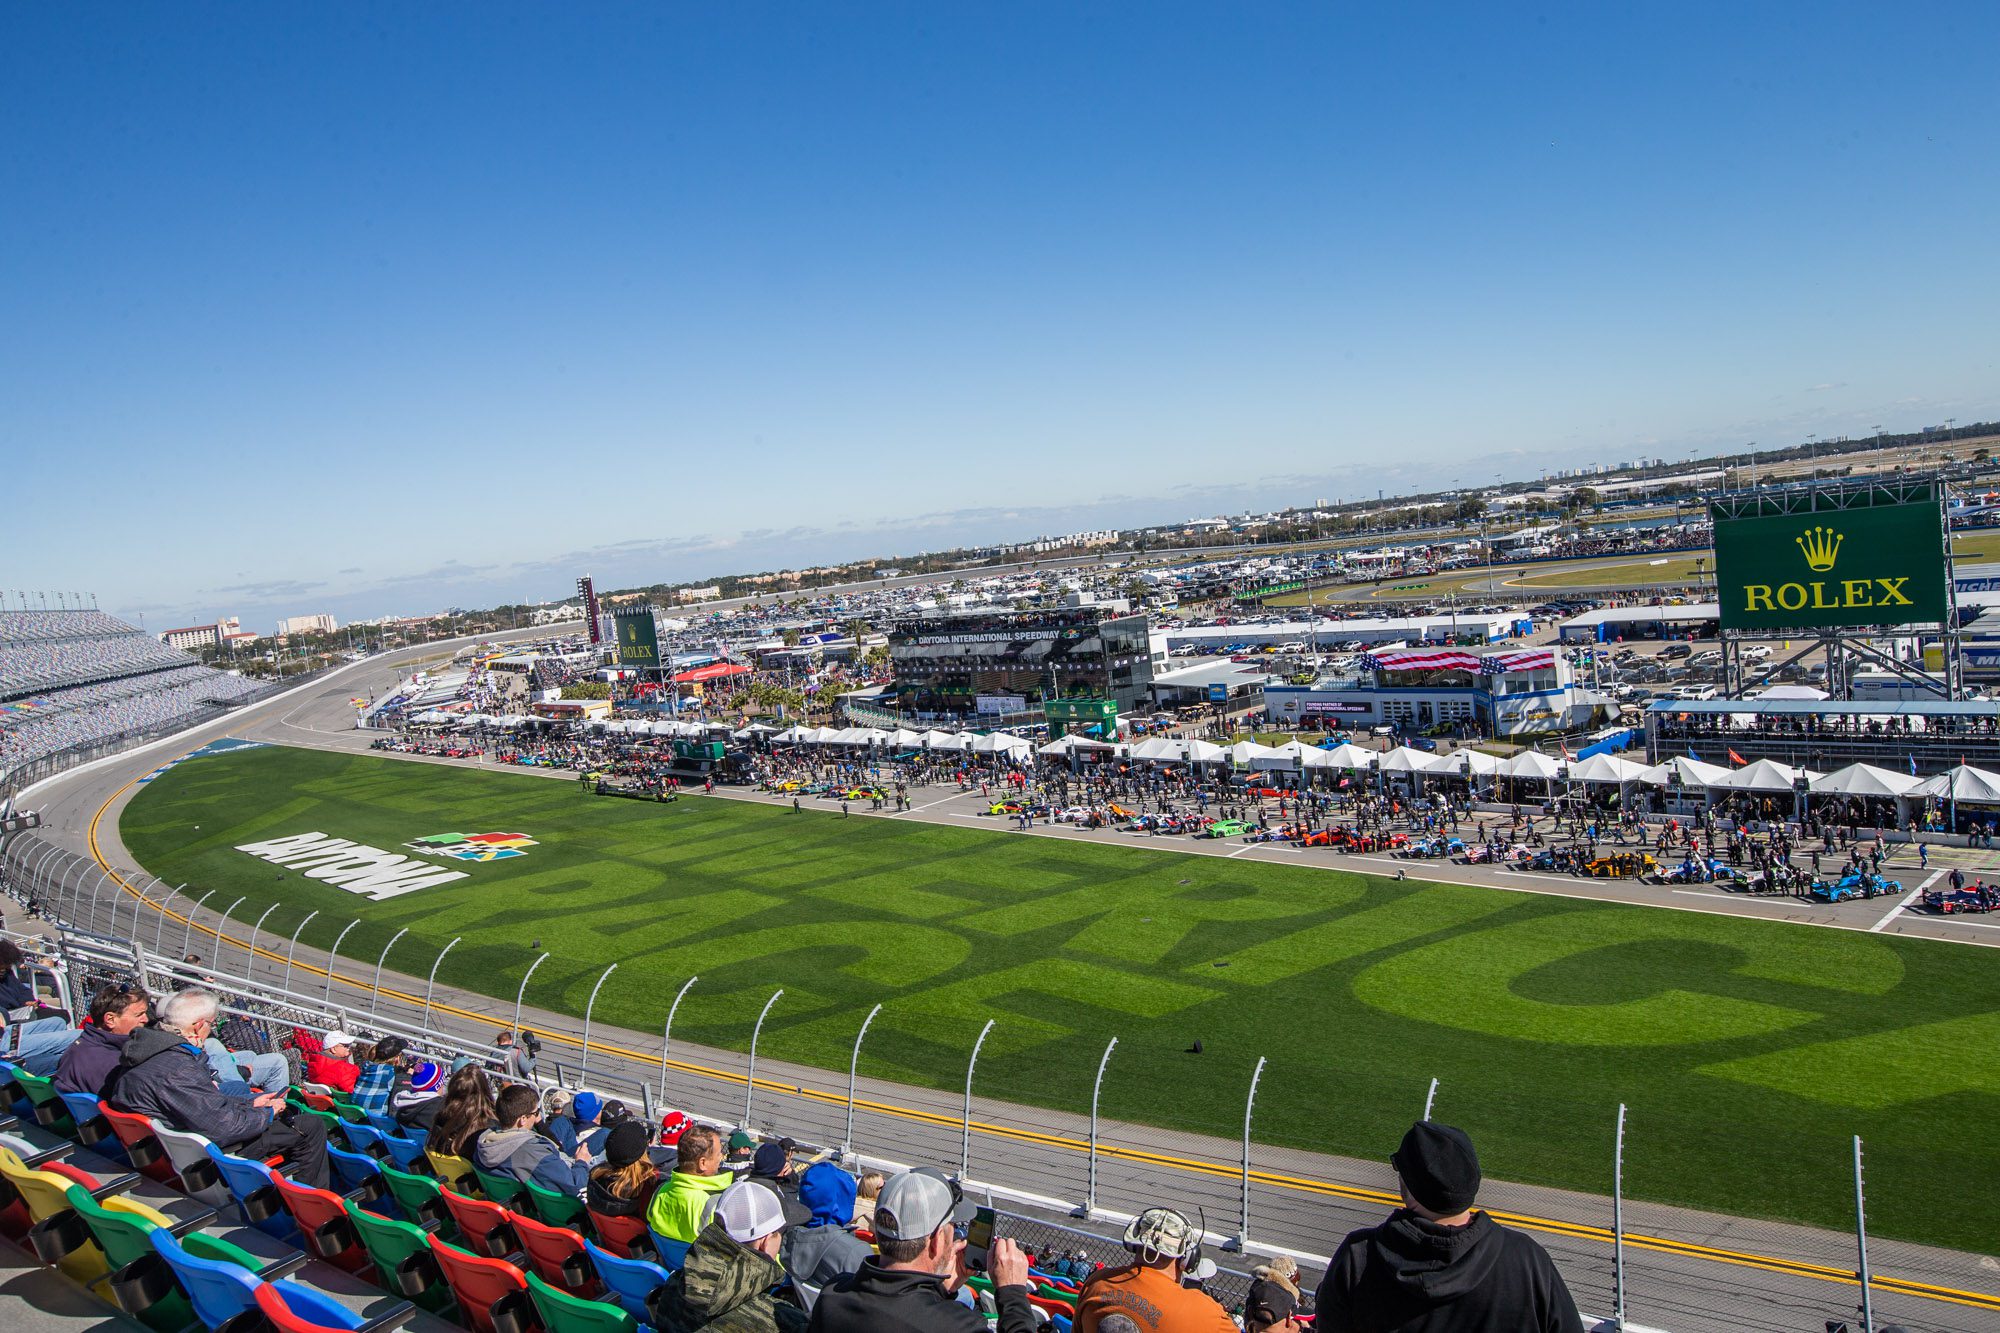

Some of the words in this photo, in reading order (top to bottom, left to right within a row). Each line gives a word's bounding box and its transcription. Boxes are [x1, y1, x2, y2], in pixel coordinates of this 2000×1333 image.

[1743, 577, 1914, 611] ROLEX
[918, 634, 950, 645] DAYTONA
[951, 632, 1013, 643] INTERNATIONAL
[1015, 630, 1060, 641] SPEEDWAY
[622, 645, 652, 658] ROLEX
[232, 831, 472, 901] DAYTONA
